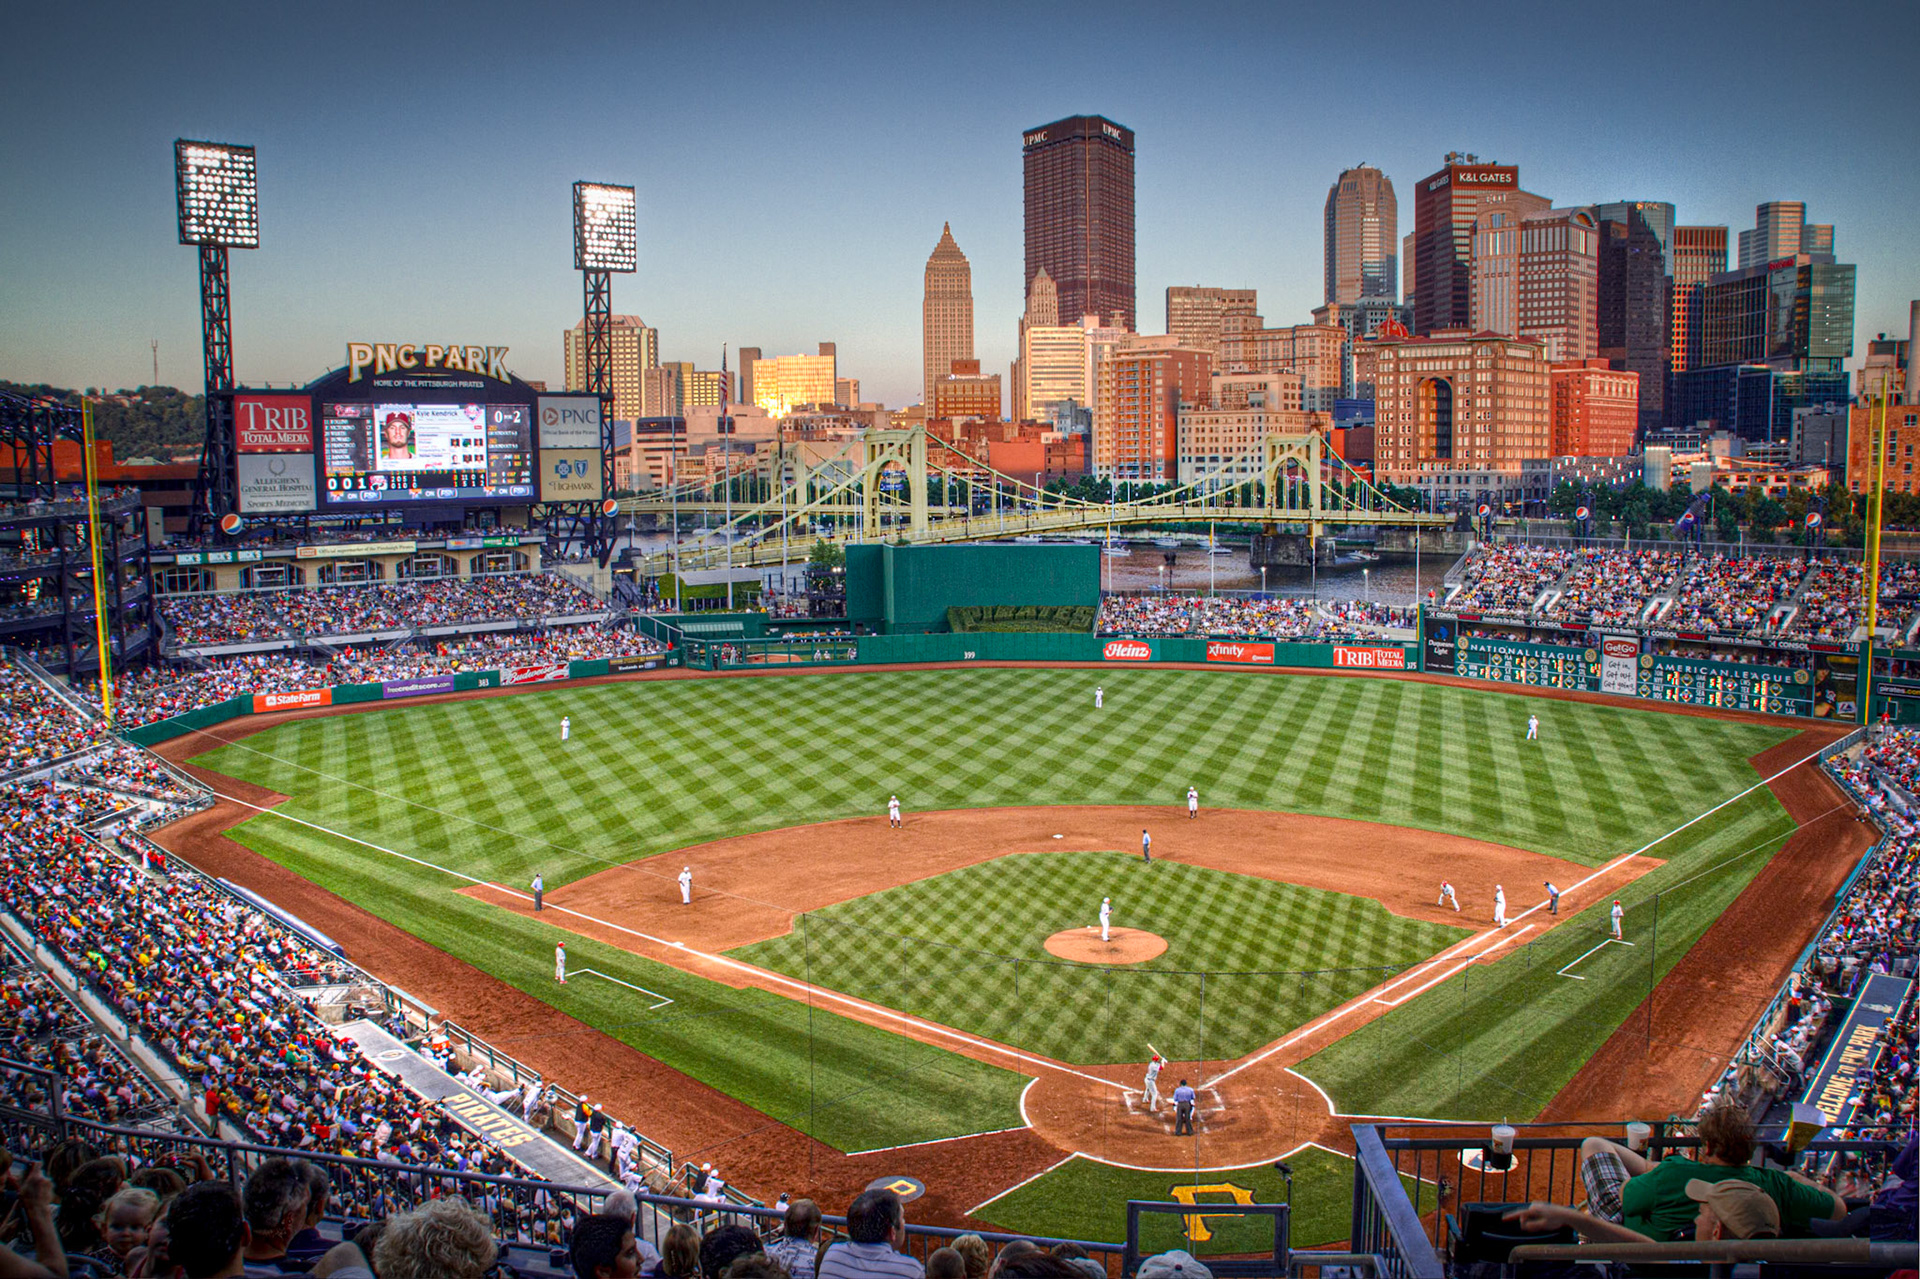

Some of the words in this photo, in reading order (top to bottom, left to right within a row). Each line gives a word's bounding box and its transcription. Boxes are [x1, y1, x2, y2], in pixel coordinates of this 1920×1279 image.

[1102, 123, 1121, 140] UPMC
[1023, 131, 1048, 146] UPMC
[1460, 173, 1478, 182] K&L
[1479, 174, 1512, 183] GATES
[347, 342, 419, 384] PNC
[424, 344, 512, 385] PARK
[418, 380, 458, 388] PITTSBURGH
[458, 380, 484, 388] PIRATES
[240, 402, 308, 430] TRIB
[512, 410, 520, 424] 2
[561, 409, 597, 424] PNC
[241, 431, 276, 443] TOTAL
[277, 432, 309, 443] MEDIA
[279, 484, 313, 492] HOSPITAL
[328, 478, 338, 490] 0
[342, 478, 352, 490] 0
[357, 477, 366, 490] 1
[550, 481, 595, 491] HIGHMARK
[178, 554, 202, 564] DICK'S
[208, 552, 232, 562] DICK'S
[238, 550, 262, 560] DICK'S
[963, 605, 1096, 632] PIRATES
[1651, 630, 1678, 638] CONSOL
[1105, 643, 1149, 658] Heinz
[1208, 644, 1244, 658] xfinity
[1434, 647, 1448, 656] Light
[1605, 642, 1636, 653] GetGo
[1778, 641, 1809, 650] CONSOL
[1845, 642, 1860, 652] 320
[964, 651, 976, 660] 399
[1334, 648, 1372, 666] TRIB
[1376, 650, 1402, 659] TOTAL
[1470, 644, 1530, 656] NATIONAL
[1534, 650, 1582, 662] LEAGUE
[1608, 660, 1620, 670] Get
[510, 666, 558, 684] Budweiser
[1606, 670, 1618, 680] Get
[1656, 663, 1729, 677] AMERICAN
[1734, 670, 1792, 684] LEAGUE
[387, 681, 451, 693] freecreditscore.com
[478, 678, 490, 688] 383
[1604, 680, 1616, 690] Get
[1848, 1024, 1880, 1049] PARK
[1838, 1045, 1869, 1066] PNC
[1815, 1074, 1856, 1123] WELCOME
[441, 1092, 534, 1148] PIRATES
[623, 1140, 629, 1148] 2
